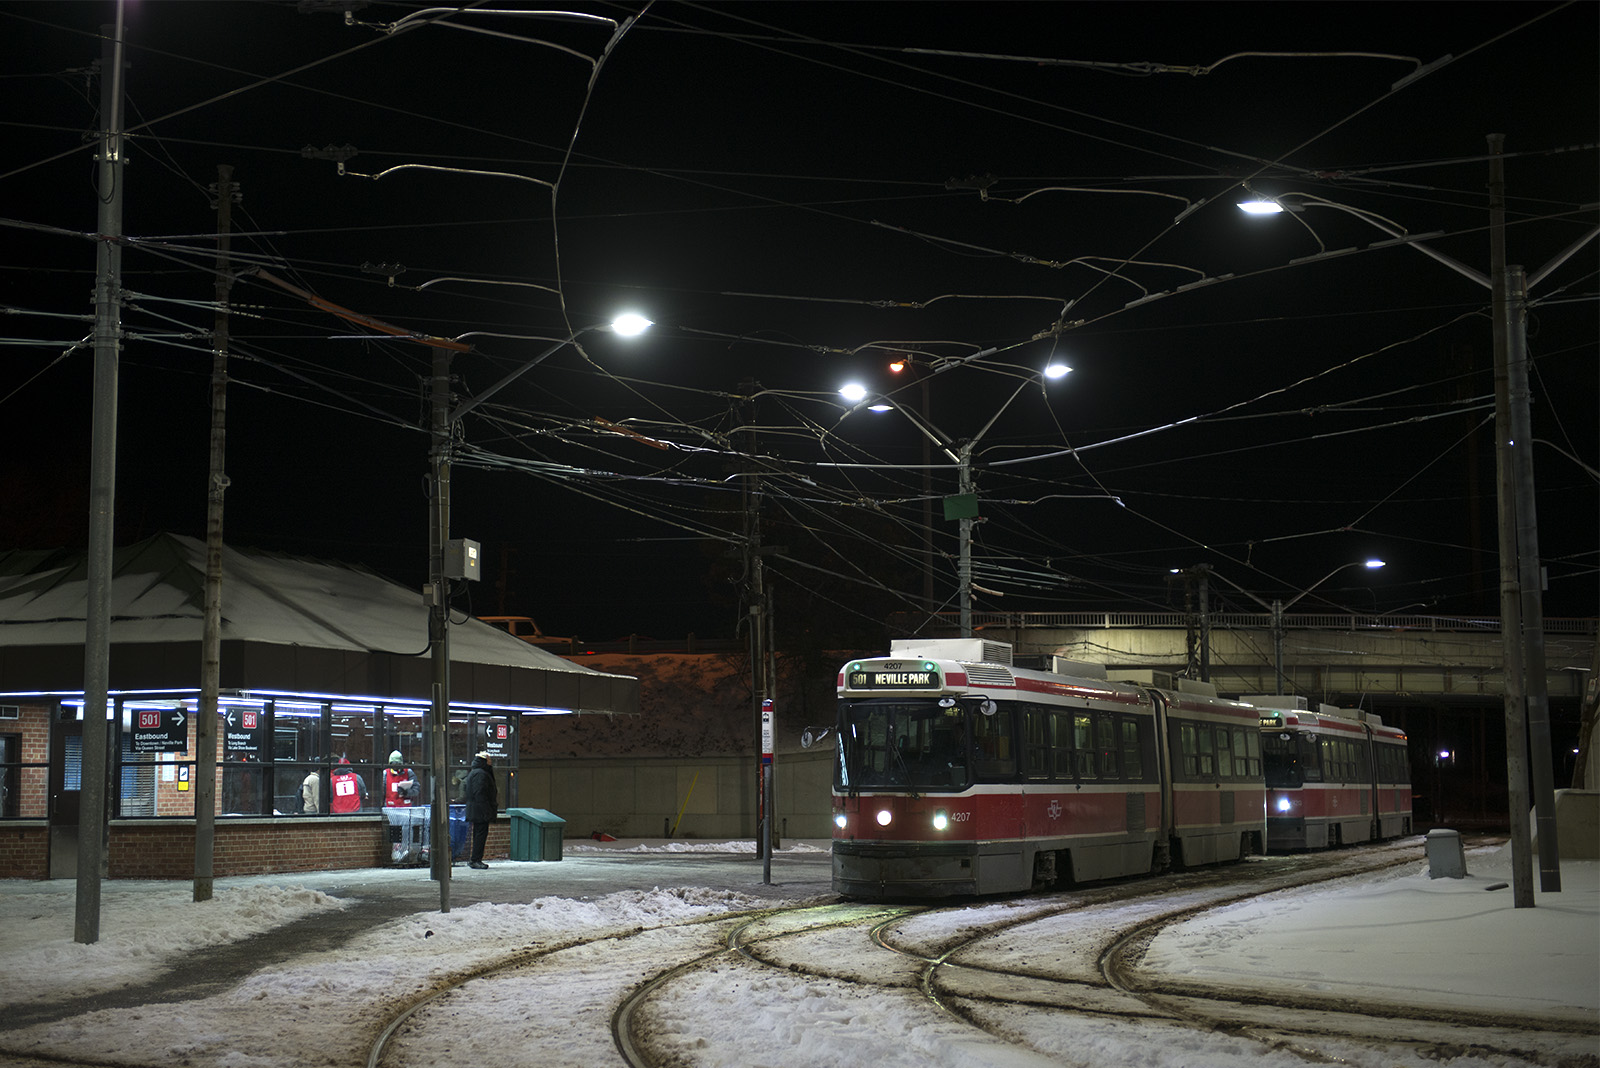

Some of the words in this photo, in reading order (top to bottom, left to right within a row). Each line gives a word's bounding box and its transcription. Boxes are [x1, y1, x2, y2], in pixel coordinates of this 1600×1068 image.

[884, 662, 902, 670] 4207
[853, 673, 867, 684] 501
[875, 673, 907, 685] NEVILLE
[908, 673, 930, 685] PARK
[142, 714, 158, 725] 501
[244, 714, 255, 726] 501
[951, 812, 971, 822] 4207
